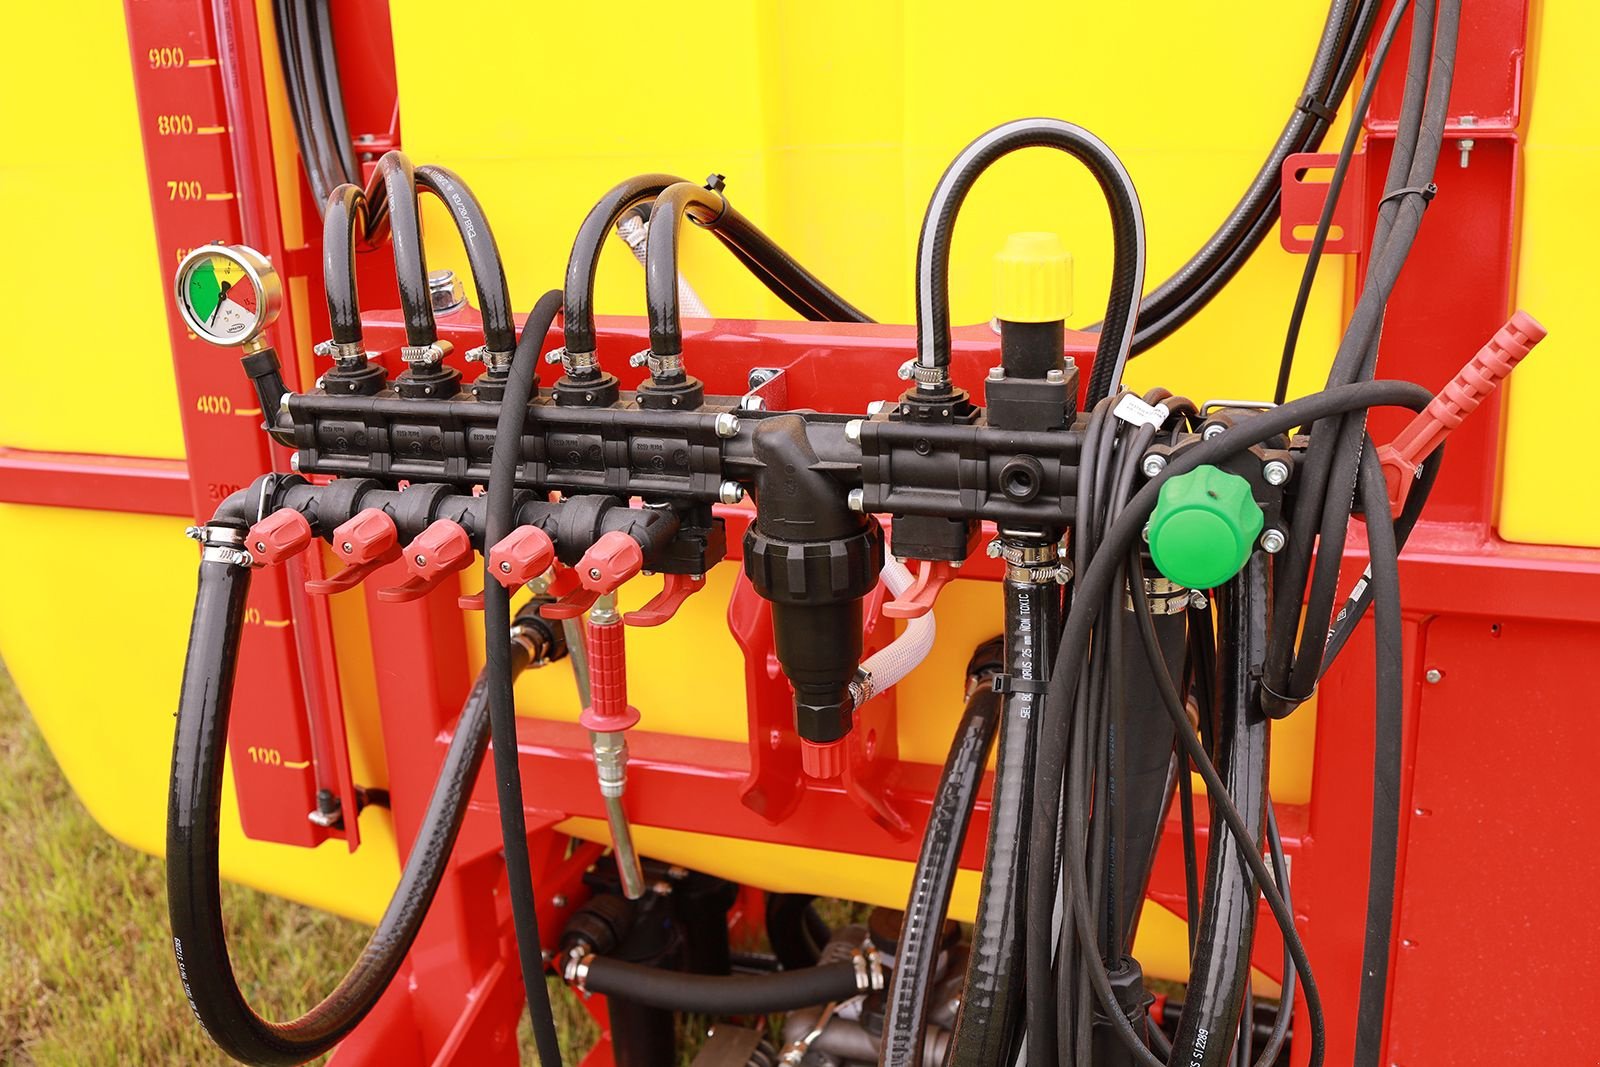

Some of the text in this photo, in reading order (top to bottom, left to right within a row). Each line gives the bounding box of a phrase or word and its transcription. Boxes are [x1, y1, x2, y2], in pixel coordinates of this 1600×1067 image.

[149, 47, 184, 69] 900
[158, 115, 192, 135] 800
[167, 181, 202, 200] 700
[197, 395, 231, 415] 400
[1018, 594, 1031, 615] TOXIC
[1022, 648, 1032, 658] 25
[1020, 705, 1031, 720] SEL
[248, 746, 280, 766] 100
